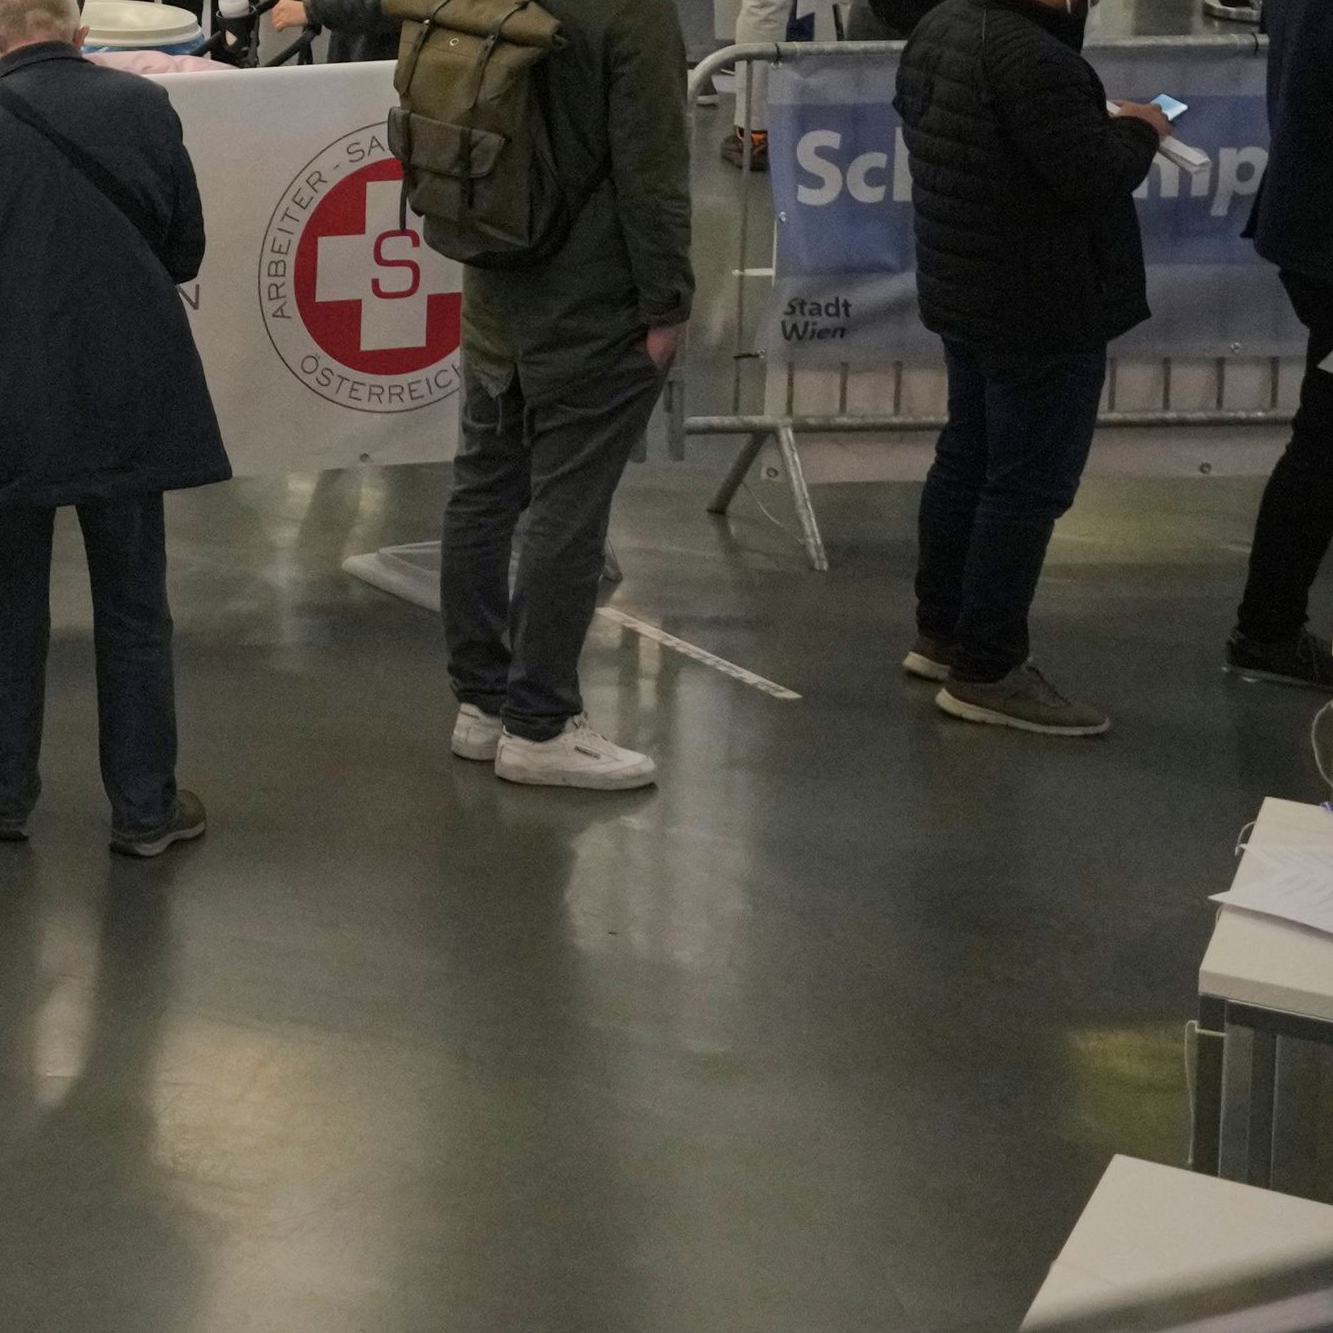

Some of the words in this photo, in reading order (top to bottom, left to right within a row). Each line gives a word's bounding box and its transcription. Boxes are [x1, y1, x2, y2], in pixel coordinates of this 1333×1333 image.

[267, 170, 328, 319] ARBEITER
[371, 228, 420, 299] S
[780, 319, 846, 341] Wien
[784, 296, 852, 318] Stadt
[300, 353, 461, 404] ÖSTERREIC
